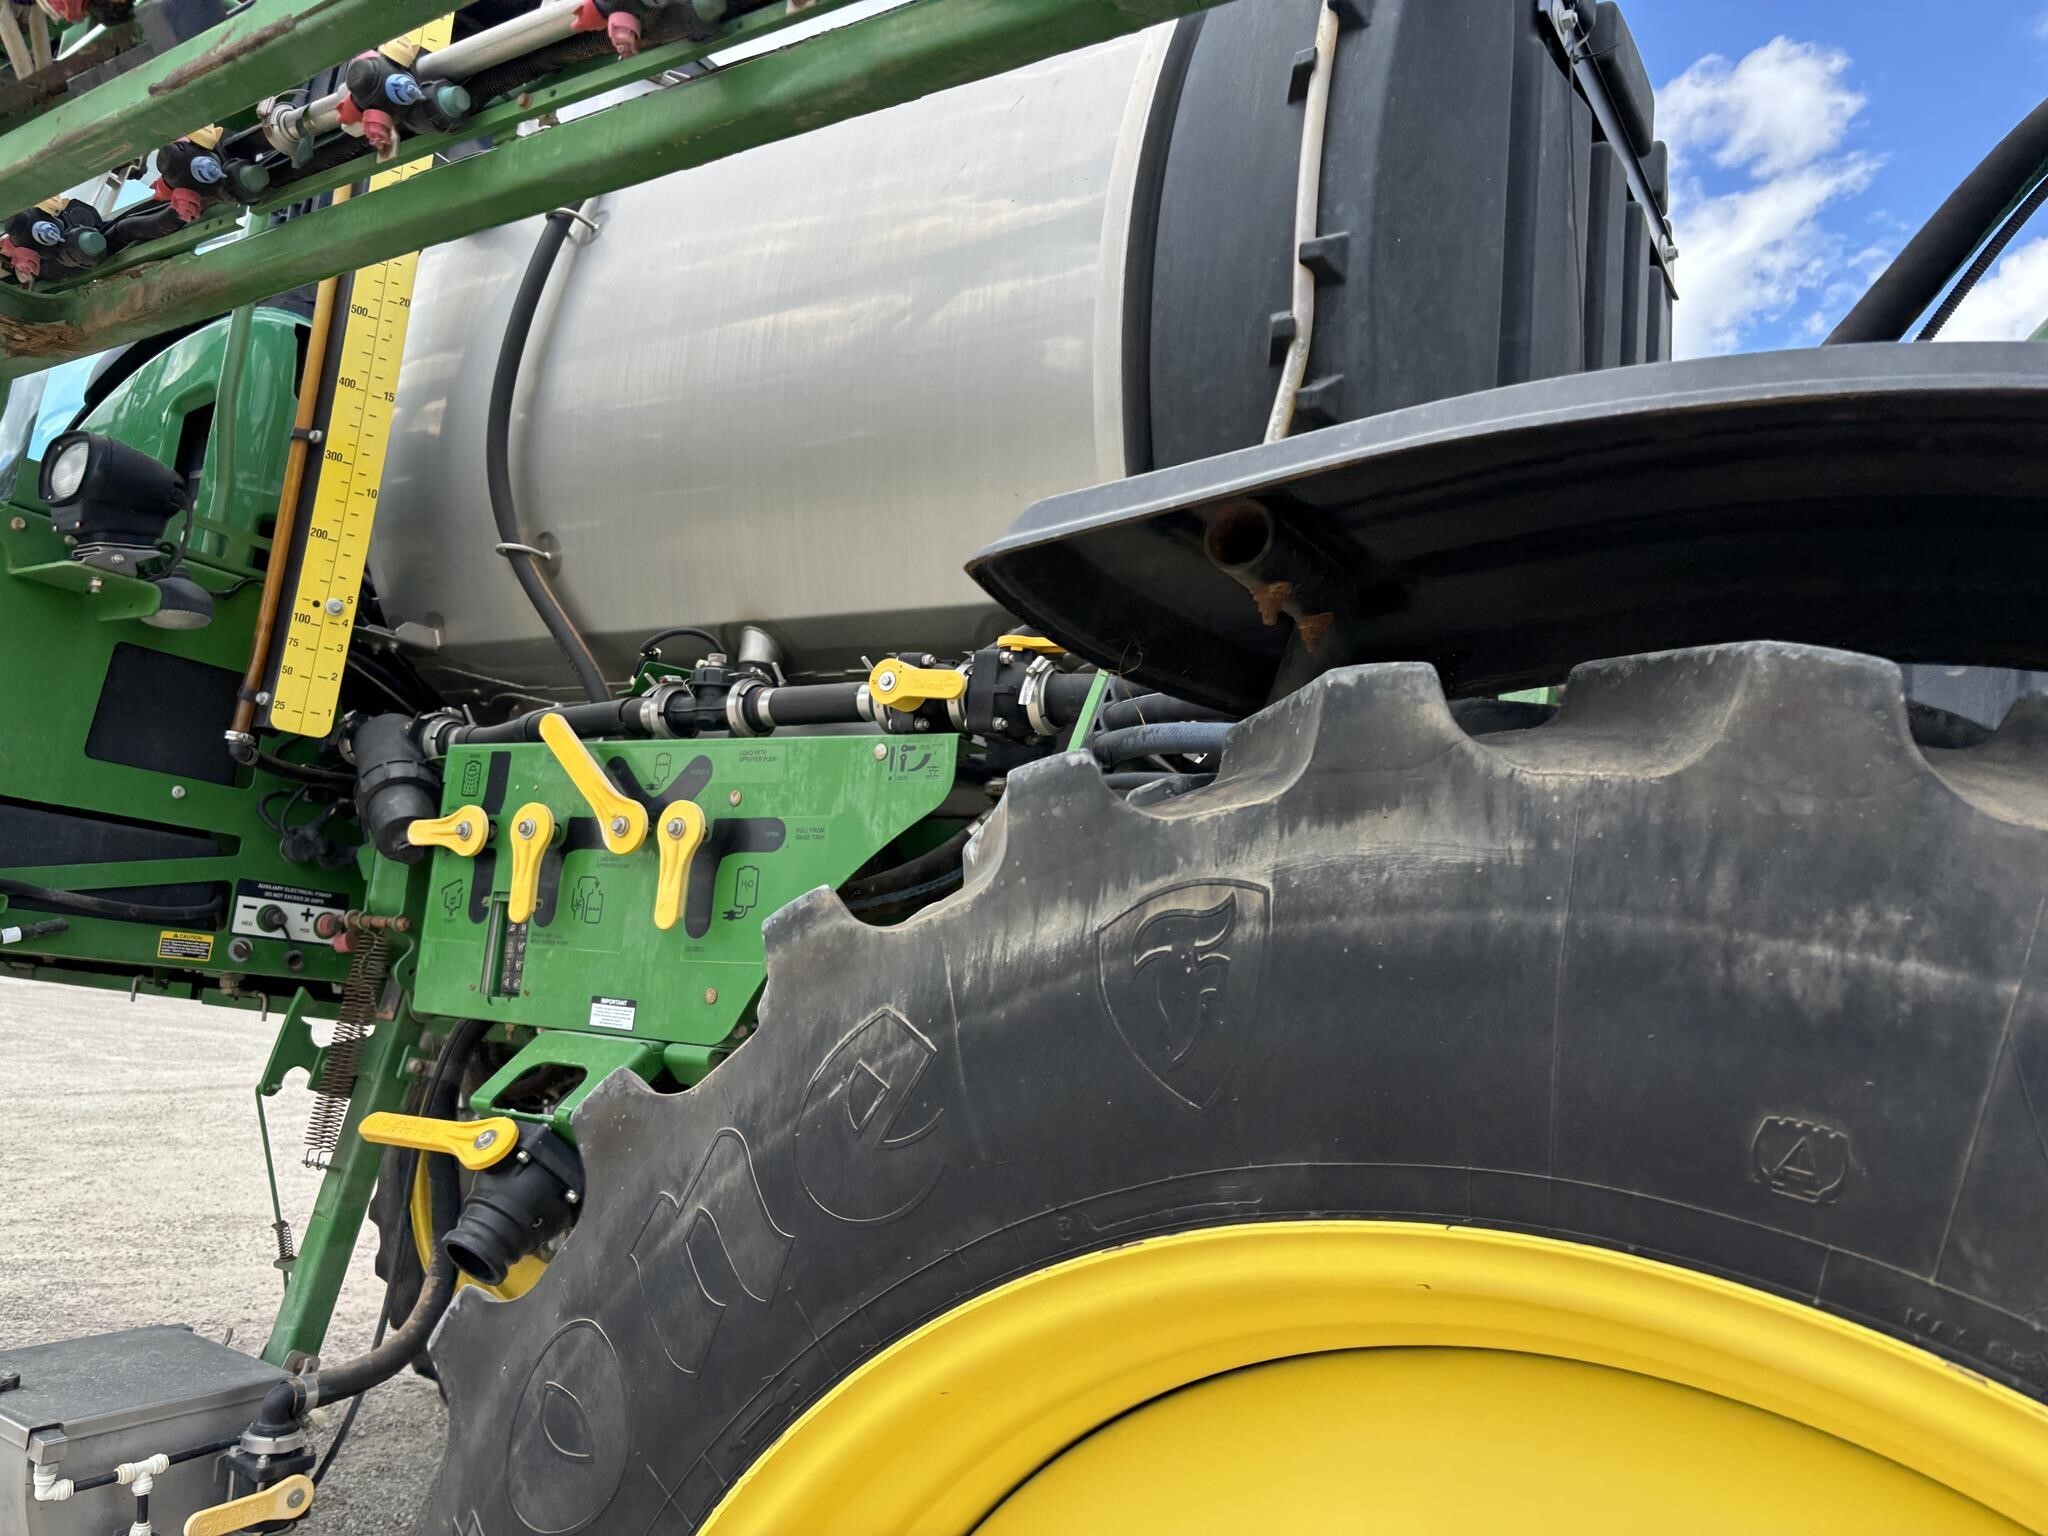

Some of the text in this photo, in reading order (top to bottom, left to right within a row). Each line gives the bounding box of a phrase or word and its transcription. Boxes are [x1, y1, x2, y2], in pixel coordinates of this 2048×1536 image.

[399, 297, 411, 308] 20
[351, 305, 368, 318] 500
[338, 378, 356, 390] 400
[383, 392, 395, 403] 15
[325, 450, 343, 463] 300
[366, 488, 377, 499] 10
[310, 527, 328, 540] 200
[347, 594, 354, 605] 5
[293, 613, 311, 625] 100
[342, 618, 349, 629] 4
[288, 637, 299, 648] 75
[337, 643, 344, 653] 3
[281, 666, 293, 676] 50
[331, 671, 338, 681] 2
[274, 700, 285, 711] 25
[258, 883, 284, 891] AUXILIARY
[284, 887, 314, 896] ELECTRICAL
[284, 894, 304, 902] EXCEED
[179, 933, 203, 941] CAUTION
[601, 998, 628, 1006] IMPORTANT
